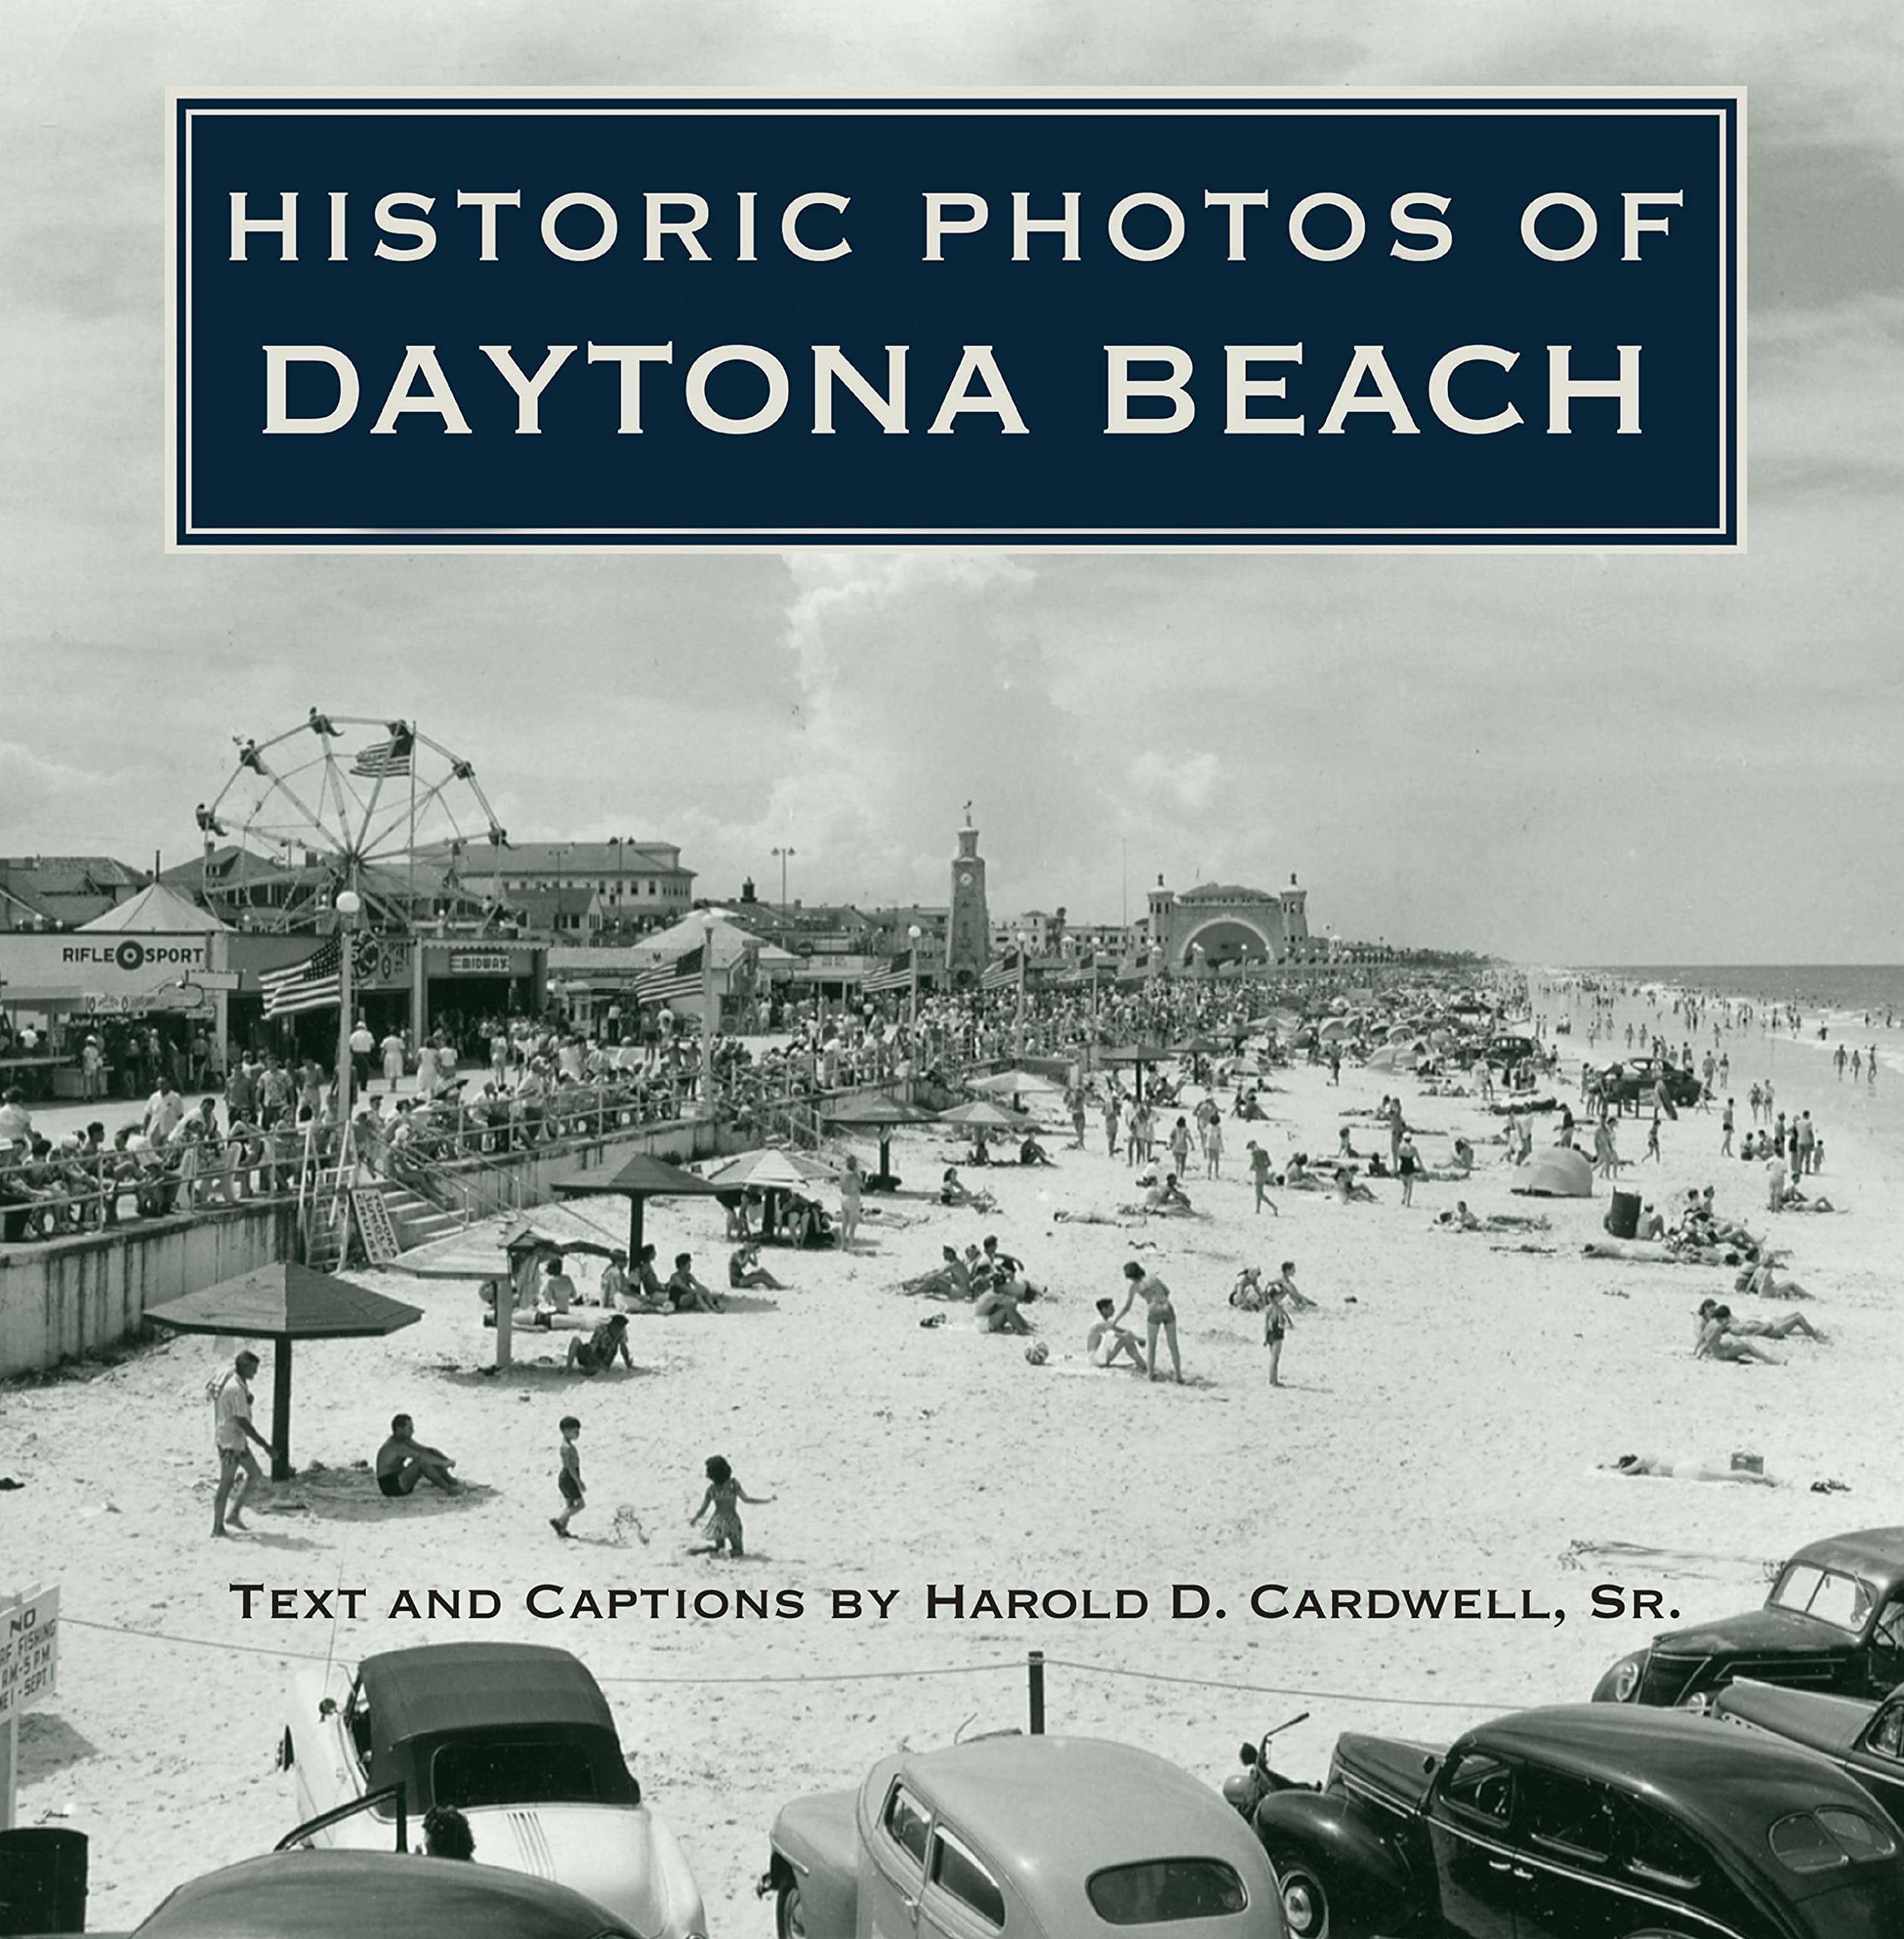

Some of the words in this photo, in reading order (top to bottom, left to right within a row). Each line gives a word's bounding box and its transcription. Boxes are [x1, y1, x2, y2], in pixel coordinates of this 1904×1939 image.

[63, 948, 114, 963] RIFLE
[145, 948, 204, 963] SPORT
[462, 957, 507, 970] MIDWAY
[10, 1608, 36, 1638] NO
[18, 1618, 56, 1656] FISHING
